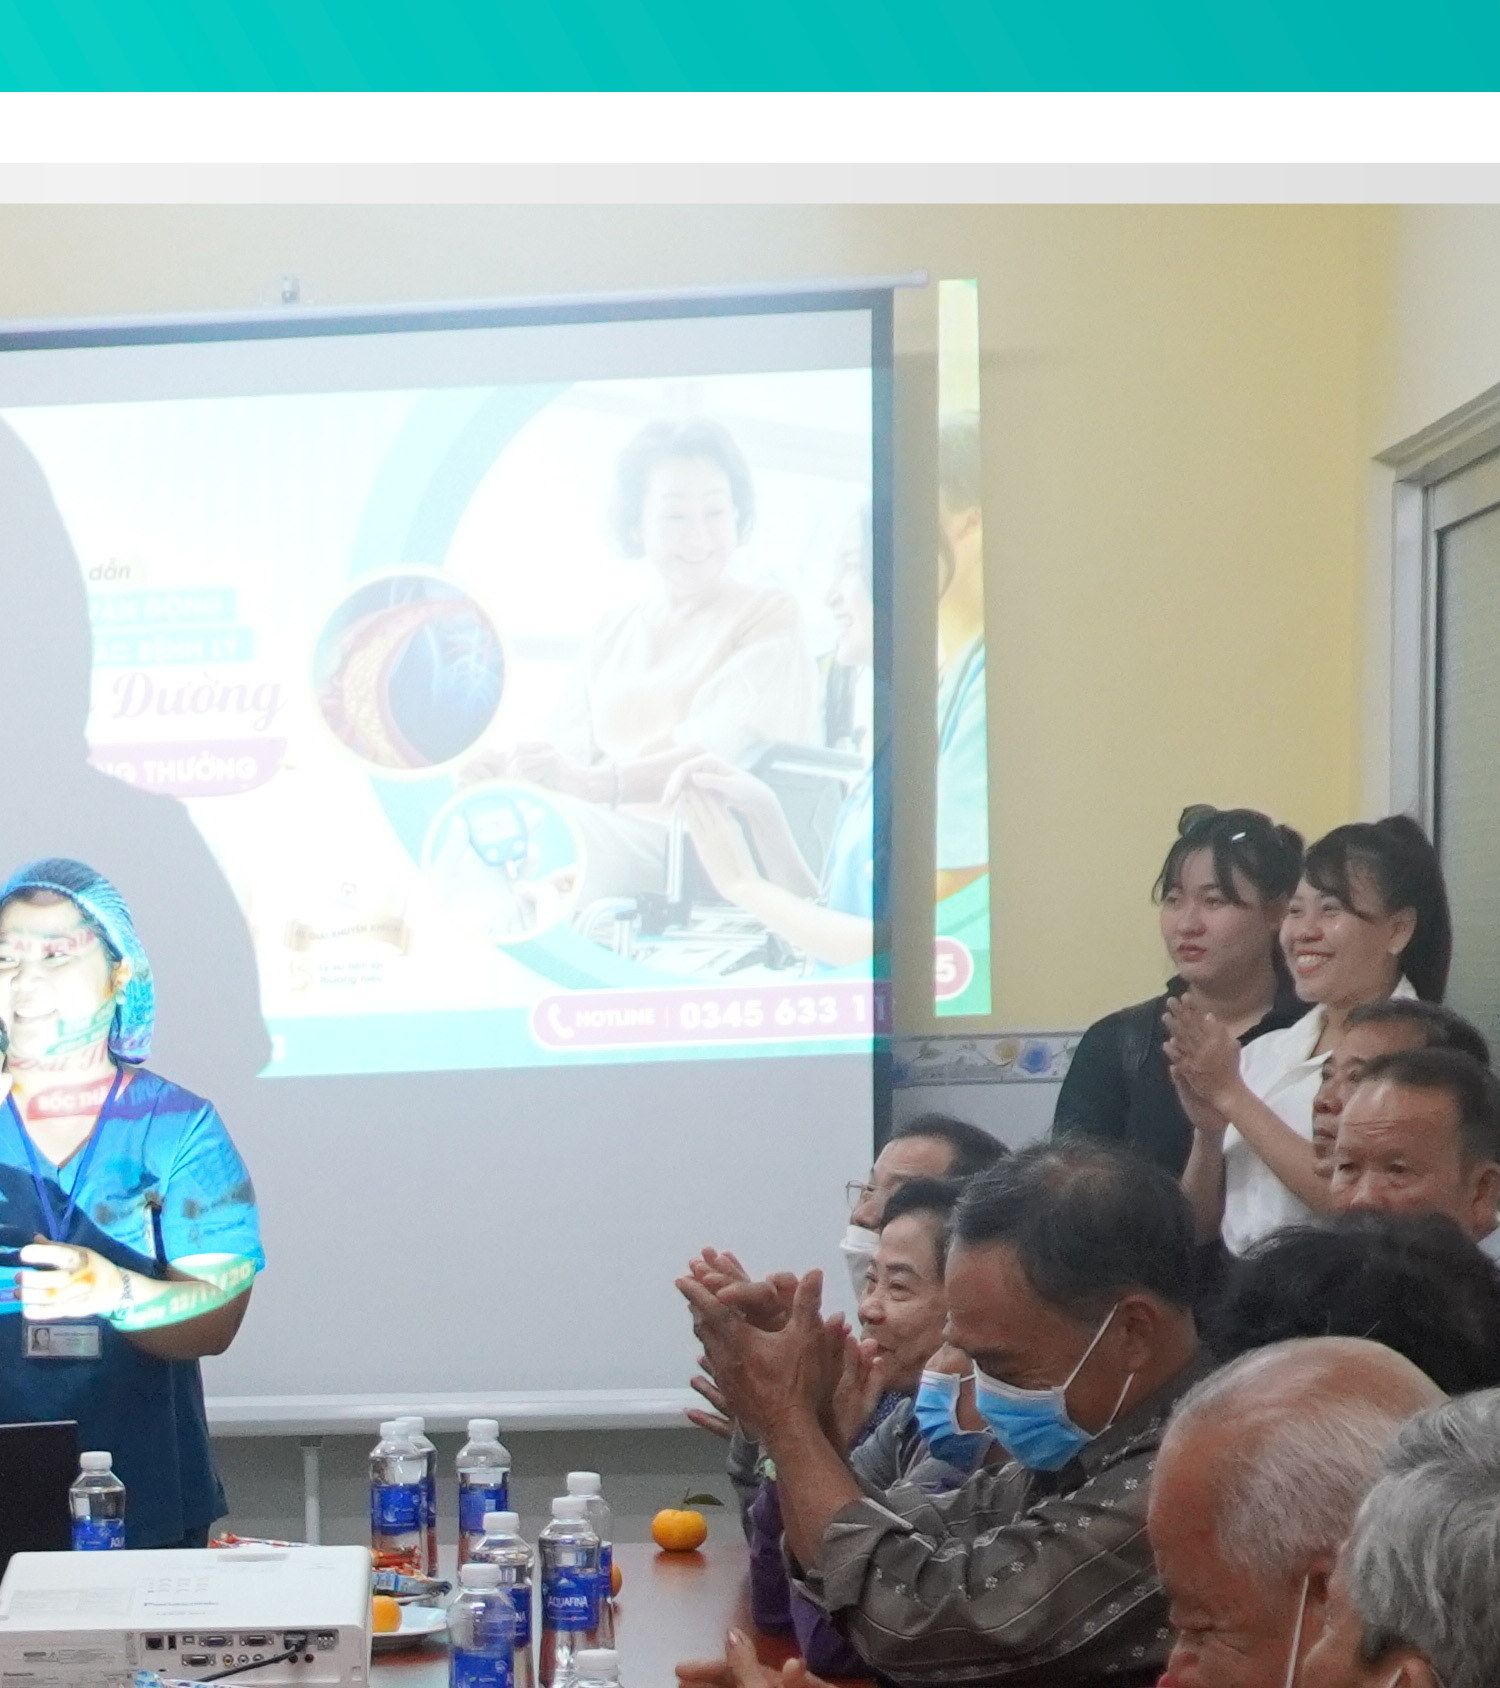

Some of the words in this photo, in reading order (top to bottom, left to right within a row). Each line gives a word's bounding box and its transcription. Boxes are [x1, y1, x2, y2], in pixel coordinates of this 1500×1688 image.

[575, 1007, 655, 1030] HOTLINE
[679, 999, 764, 1031] 0345
[774, 996, 838, 1027] 633
[547, 1595, 588, 1608] AQUAFINA
